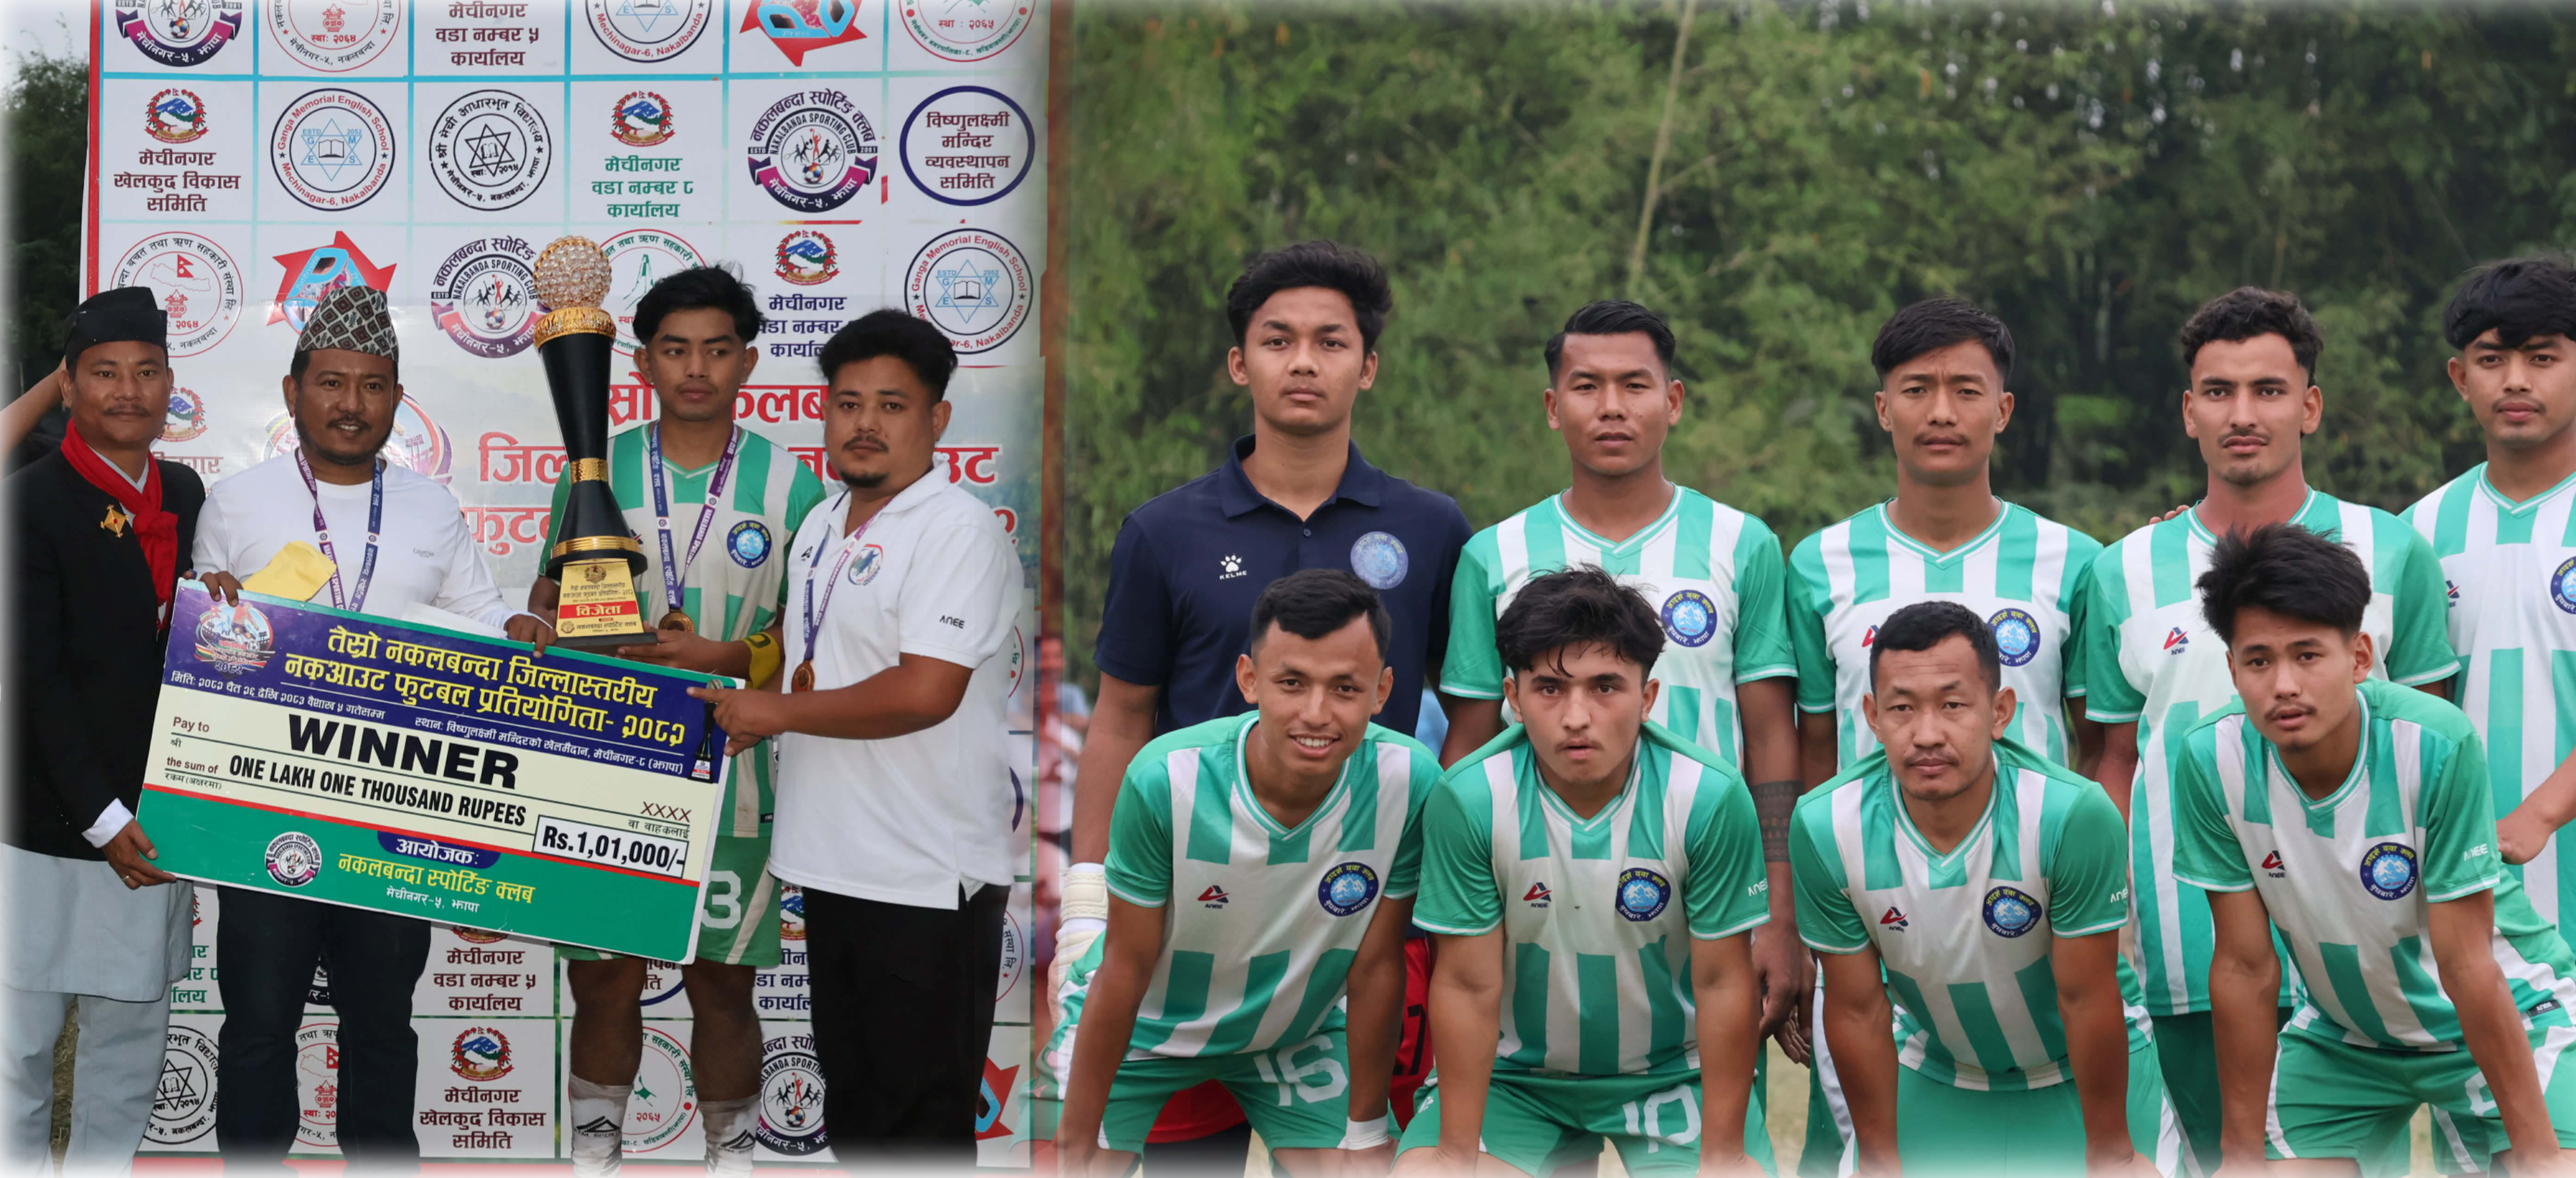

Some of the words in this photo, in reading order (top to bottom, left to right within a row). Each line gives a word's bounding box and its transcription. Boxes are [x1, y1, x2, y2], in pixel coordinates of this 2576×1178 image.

[449, 1, 528, 18] मेचीनगर
[197, 32, 222, 55] झापा
[333, 35, 356, 44] २०६४
[435, 28, 469, 42] वडा
[473, 28, 524, 42] नम्बर
[529, 27, 539, 44] ५
[597, 13, 654, 57] Mechinagar-6,
[656, 12, 702, 56] Nakalbanda
[450, 48, 526, 66] कार्यालय
[277, 118, 294, 150] Ganga
[292, 95, 335, 118] Memorial
[338, 95, 372, 118] English
[371, 116, 390, 150] School
[750, 92, 804, 142] नकलबन्दा
[852, 110, 876, 143] क्लब
[926, 111, 1011, 131] विष्णुलक्ष्मी
[769, 114, 807, 155] NAKALBANDA
[809, 112, 847, 135] SPORTING
[843, 133, 856, 154] CLUB
[941, 132, 994, 149] मन्दिर
[139, 148, 216, 165] मेचीनगर
[605, 155, 683, 172] मेचीनगर
[925, 155, 1011, 169] व्यवस्थापन
[114, 171, 178, 193] खेलकुद
[182, 171, 241, 189] विकास
[282, 163, 338, 206] Mechinagar-6,
[341, 163, 386, 204] Nakalbanda
[591, 181, 624, 195] वडा
[628, 181, 679, 195] नम्बर
[683, 181, 694, 195] ८
[832, 177, 858, 201] झापा
[940, 172, 996, 189] समिति
[147, 194, 207, 212] समिति
[607, 201, 681, 218] कार्यालय
[148, 238, 169, 251] तथा
[433, 239, 487, 286] नकलबन्दा
[911, 260, 928, 292] Ganga
[926, 235, 971, 260] Memorial
[975, 235, 1009, 258] English
[1009, 256, 1028, 291] School
[452, 260, 489, 300] NAKALBANDA
[491, 259, 528, 281] SPORTING
[524, 280, 538, 300] CLUB
[768, 294, 847, 311] मेचीनगर
[792, 320, 843, 334] नम्बर
[976, 304, 1023, 348] Nakalbanda
[1219, 570, 1247, 580] KELME
[576, 604, 622, 617] विजेता
[328, 625, 382, 658] तेस्रो
[386, 639, 503, 681] नकलबन्दा
[507, 655, 658, 709] जिल्लास्तरीय
[285, 653, 390, 692] नकआउट
[394, 673, 474, 708] फुटबल
[226, 680, 241, 694] चैत
[258, 687, 279, 700] देखि
[307, 695, 334, 711] वैशाख
[345, 703, 386, 720] गतेसम्म
[173, 716, 194, 733] Pay
[198, 721, 209, 733] to
[446, 721, 497, 739] विष्णुलक्ष्मी
[498, 731, 542, 747] मन्दिरको
[170, 738, 182, 748] श्री
[289, 713, 519, 790] WINNER
[167, 756, 182, 768] the
[184, 760, 205, 773] sum
[207, 764, 219, 774] of
[229, 755, 266, 780] ONE
[269, 762, 316, 789] LAKH
[320, 771, 356, 796] ONE
[361, 778, 454, 813] THOUSAND
[458, 796, 526, 826] RUPEES
[641, 801, 692, 822] XXXX
[543, 825, 685, 871] Rs.1,01,000/-
[338, 853, 424, 885] नकलबन्दा
[496, 881, 536, 903] क्लब
[452, 898, 480, 912] झापा
[446, 947, 525, 964] मेचीनगर
[433, 973, 466, 988] वडा
[470, 974, 521, 988] नम्बर
[526, 974, 537, 990] ५
[448, 994, 523, 1011] कार्यालय
[1253, 1033, 1348, 1107] 16
[444, 1086, 522, 1103] मेचीनगर
[419, 1109, 484, 1130] खेलकुद
[488, 1108, 546, 1126] विकास
[1622, 1083, 1701, 1154] 10
[452, 1131, 513, 1149] समिति
